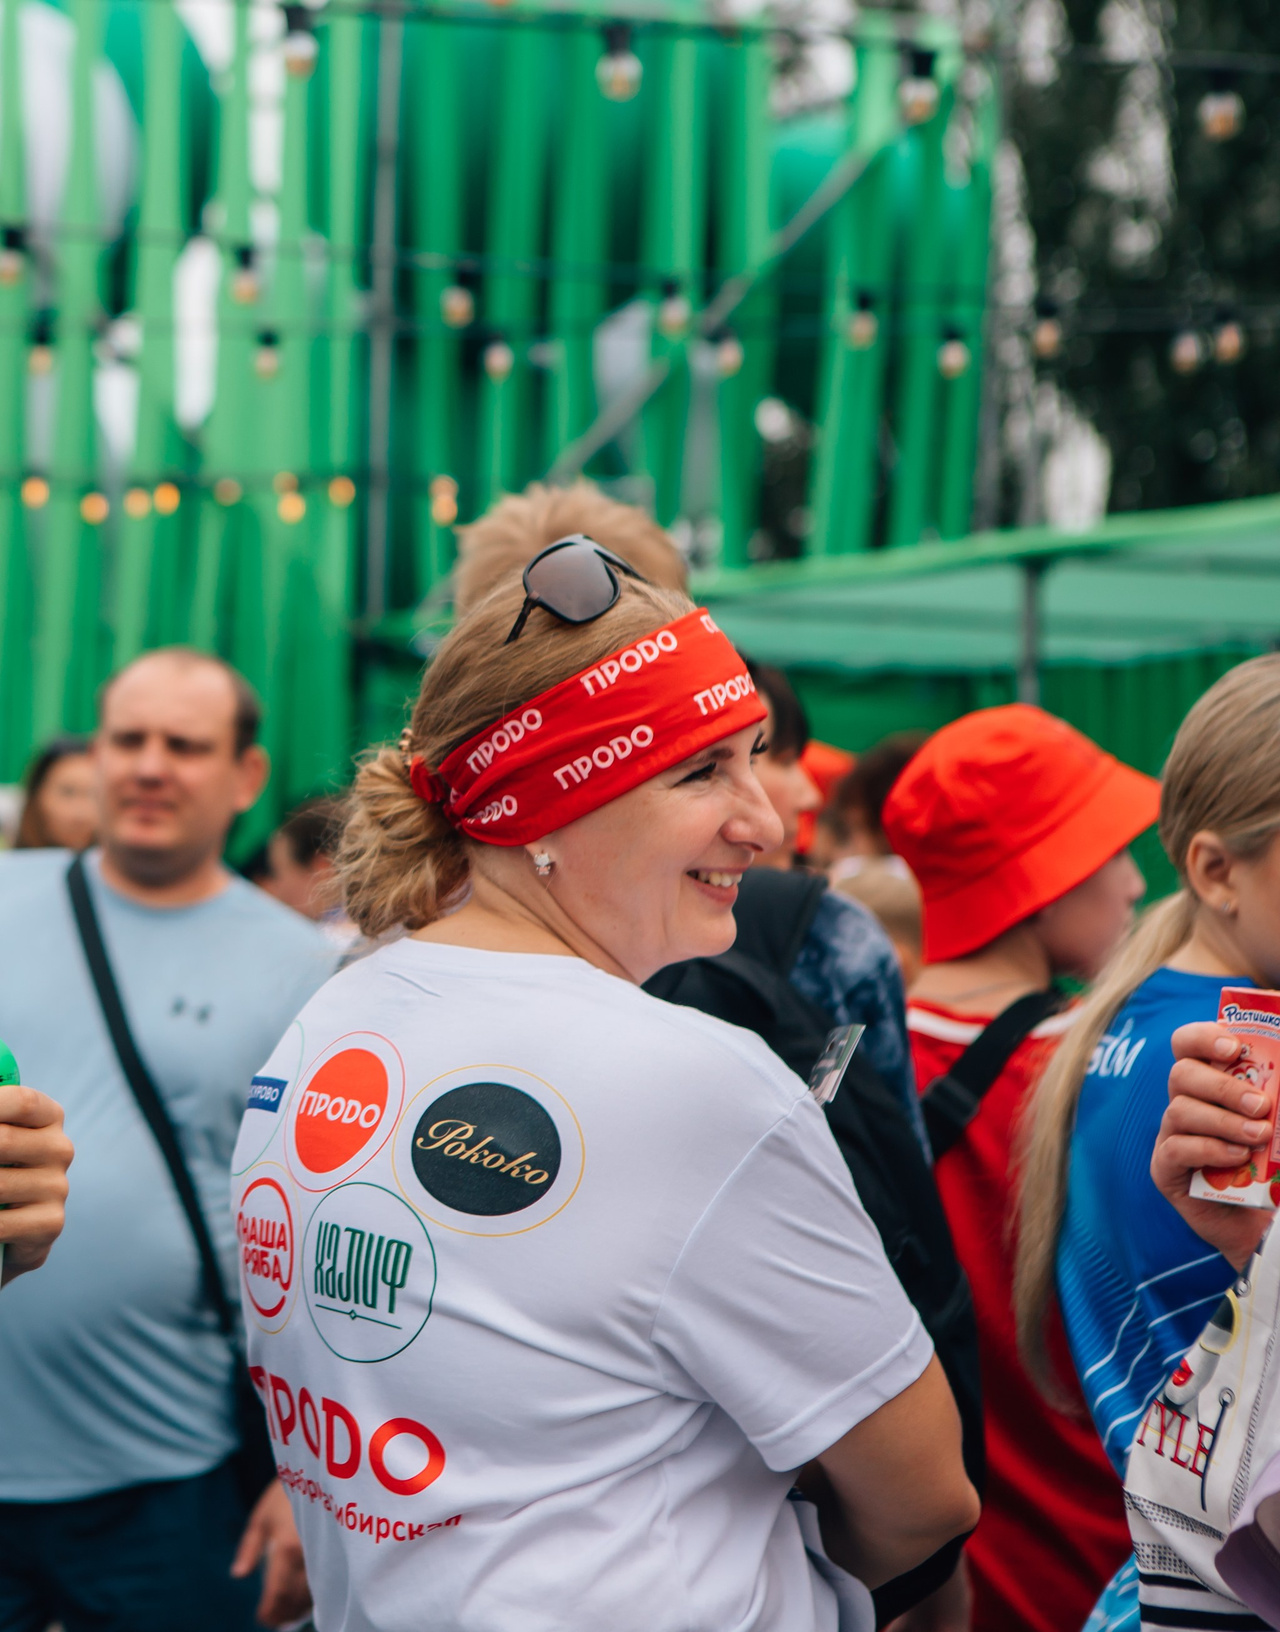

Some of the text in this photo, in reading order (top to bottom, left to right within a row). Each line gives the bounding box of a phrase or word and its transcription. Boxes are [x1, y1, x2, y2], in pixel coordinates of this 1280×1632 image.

[1223, 1004, 1280, 1027] Растишка
[240, 1215, 288, 1252] НАША
[244, 1246, 282, 1282] РЯБА
